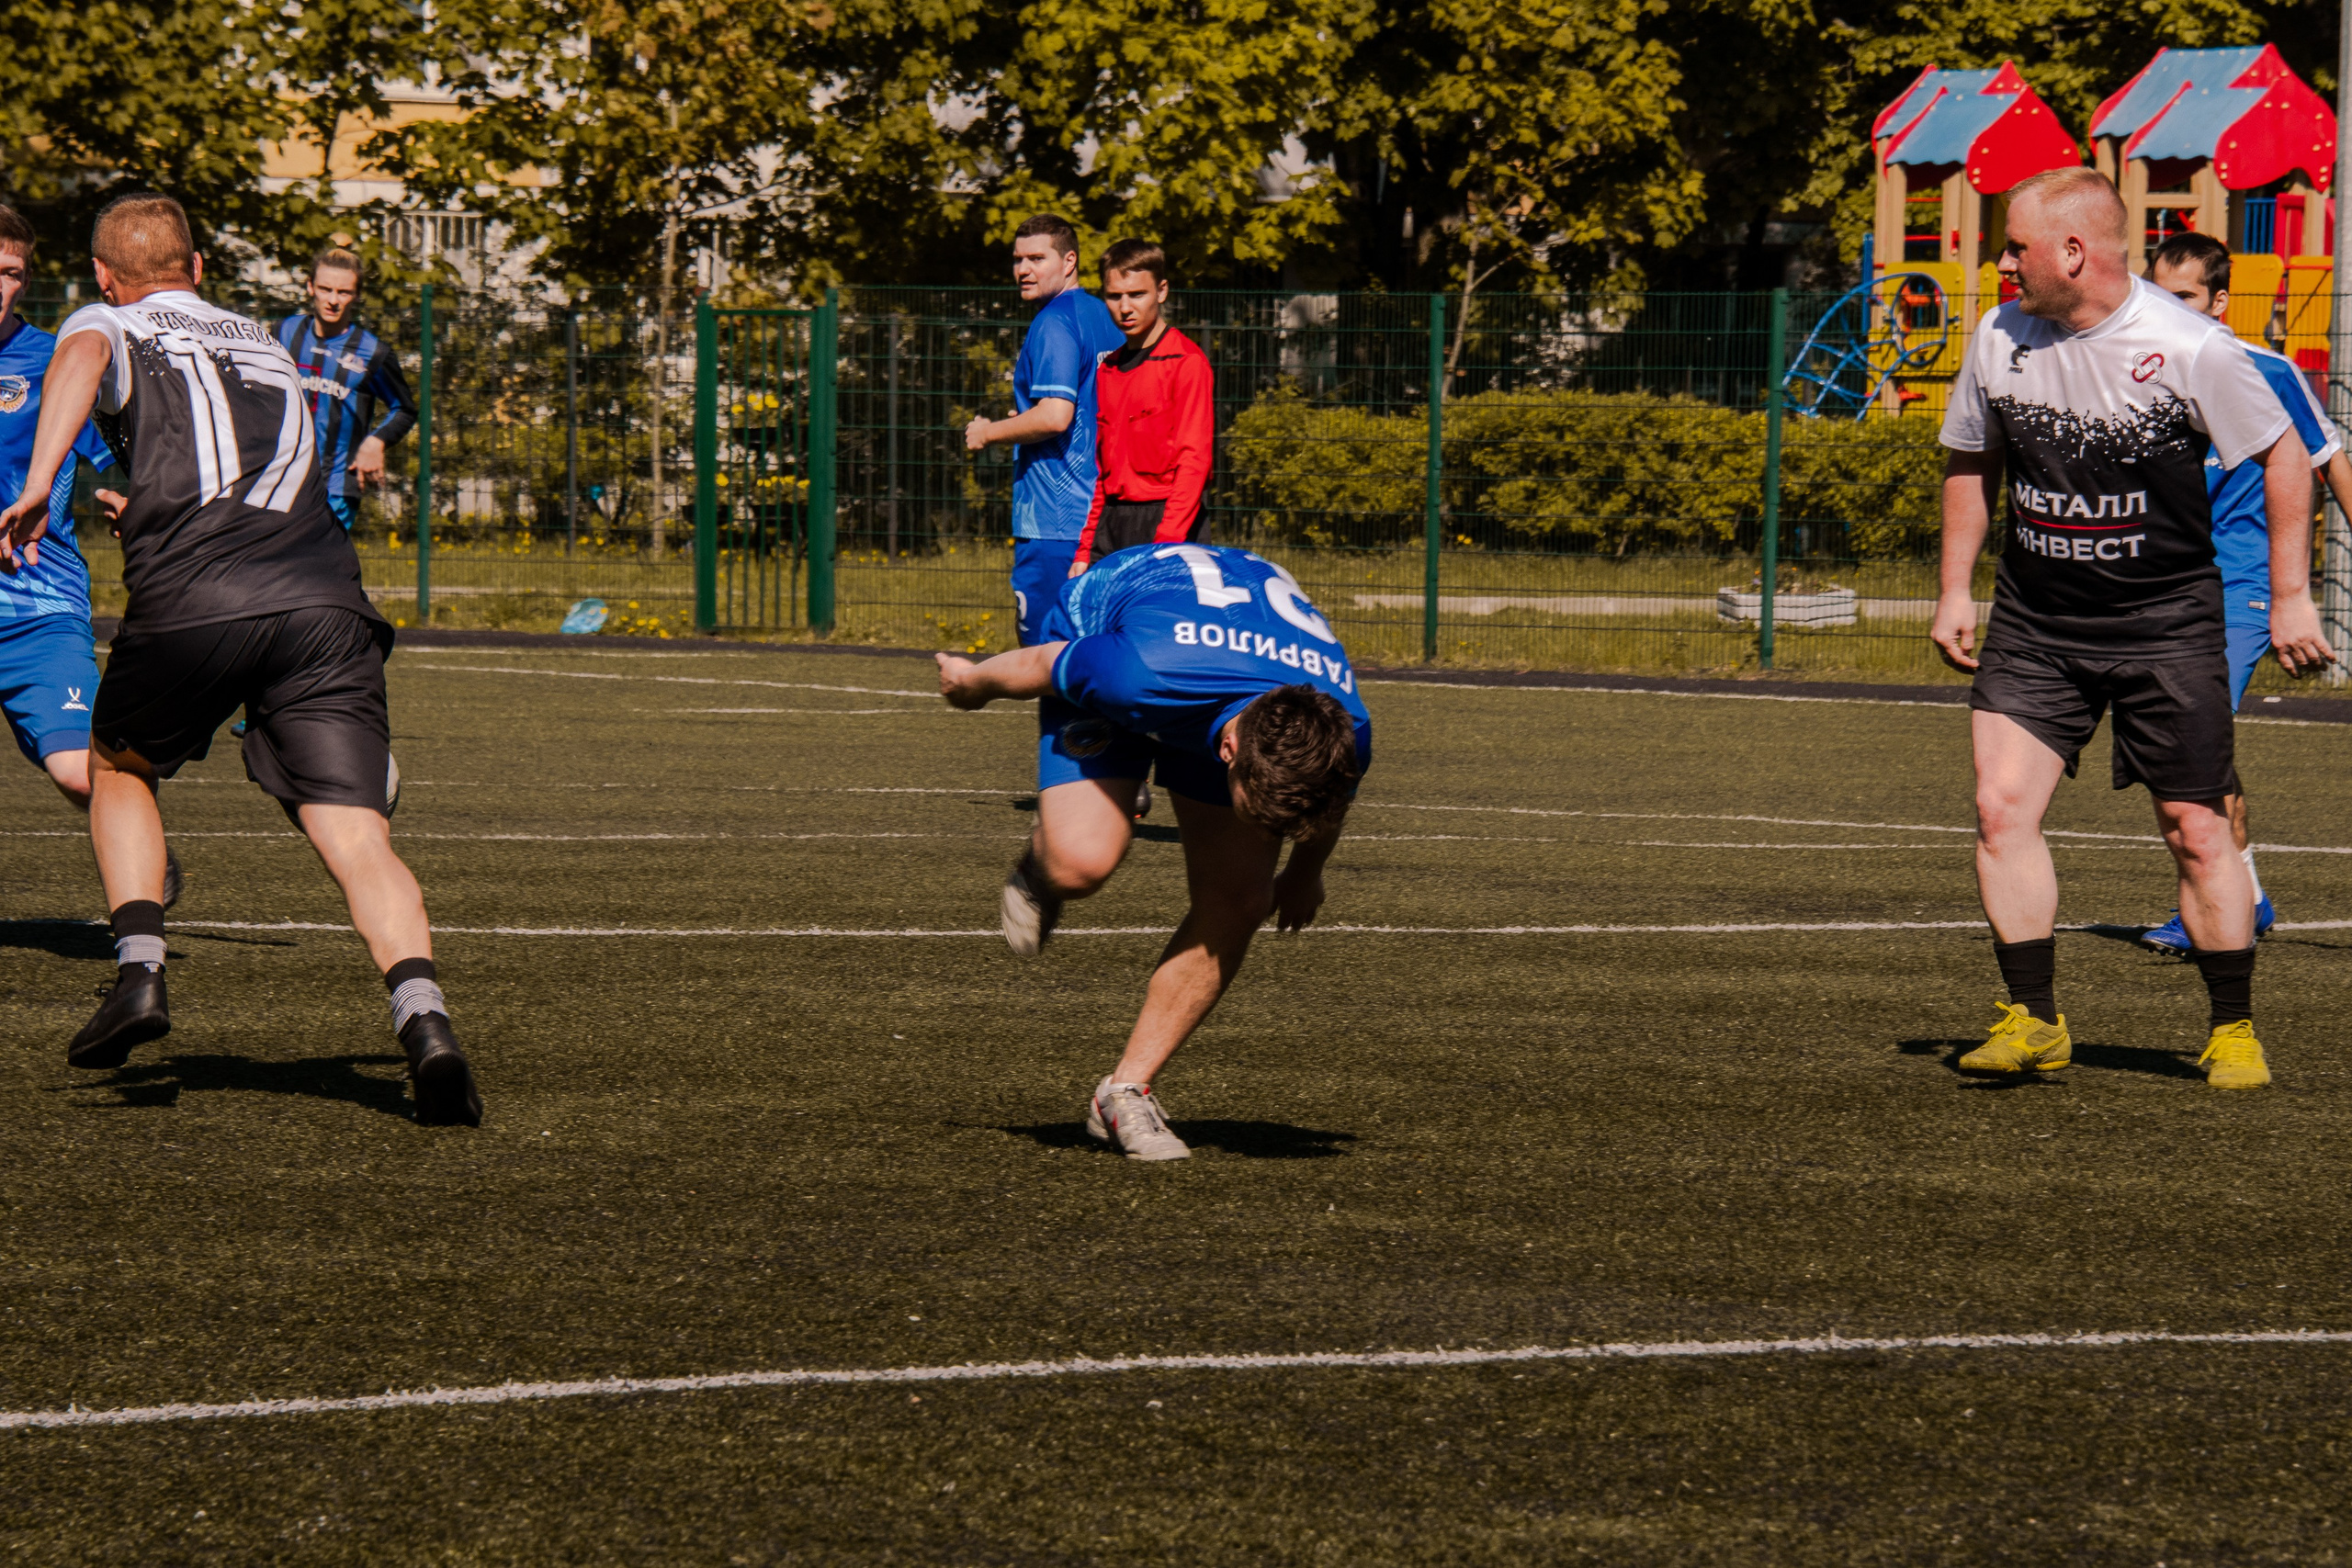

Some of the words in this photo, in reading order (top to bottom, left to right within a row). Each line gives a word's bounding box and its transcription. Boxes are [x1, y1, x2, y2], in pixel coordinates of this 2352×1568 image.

[154, 333, 315, 513] 17
[2015, 480, 2148, 519] МЕТАЛЛ
[2016, 524, 2146, 561] ИНВЕСТ
[1173, 622, 1353, 694] ГАВРИЛОВ
